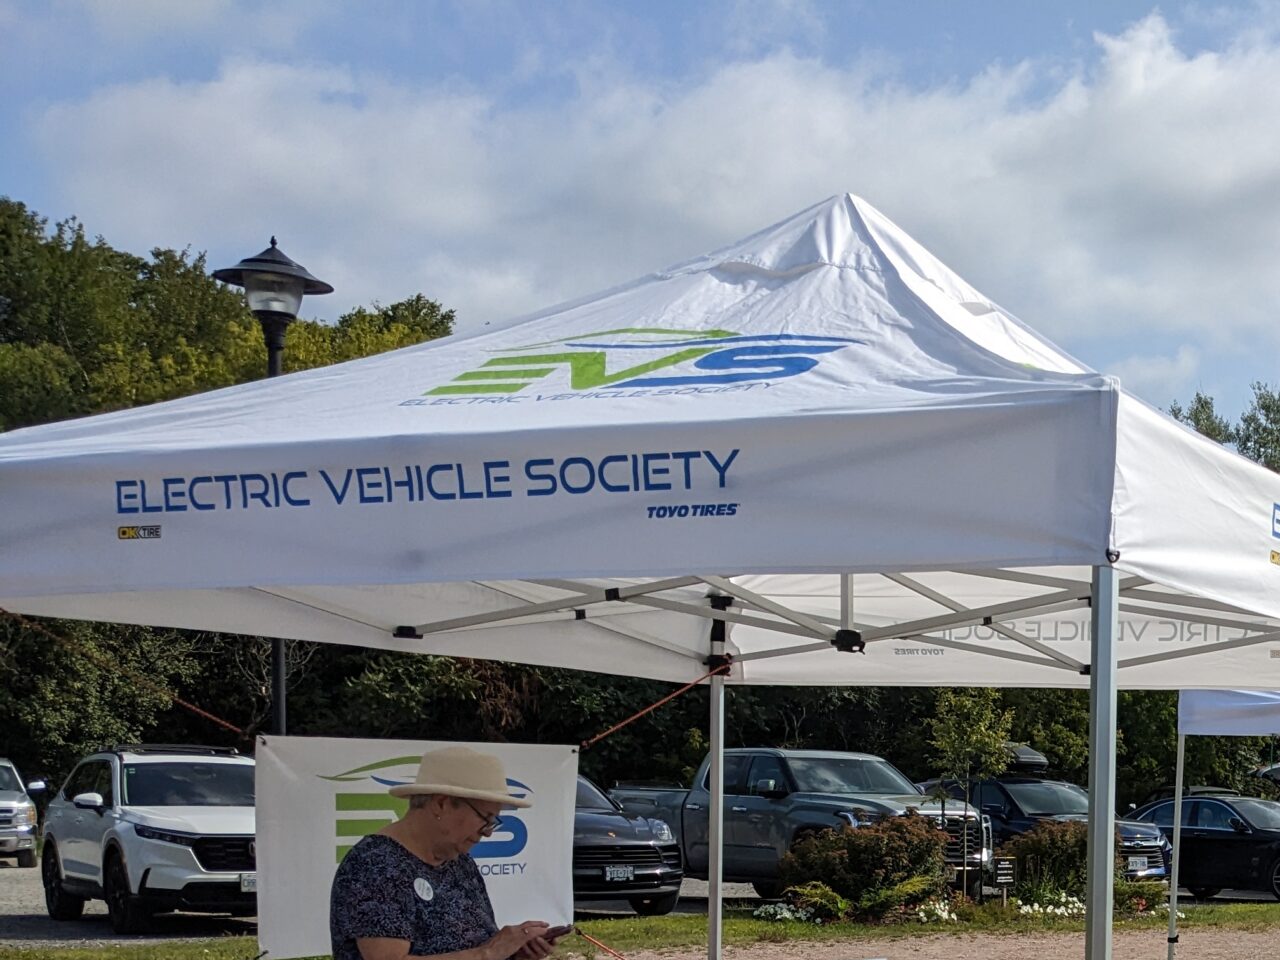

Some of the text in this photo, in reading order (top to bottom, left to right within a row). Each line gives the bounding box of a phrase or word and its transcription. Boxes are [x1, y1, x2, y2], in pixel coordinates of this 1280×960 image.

[423, 345, 850, 396] EVS
[398, 381, 785, 407] ELECTRIC VEHICLE SOCIETY
[115, 448, 740, 515] ELECTRIC VEHICLE SOCIETY
[647, 503, 738, 519] TOYO TIRES
[119, 526, 161, 539] OK TIRE
[477, 862, 527, 876] OCIETY
